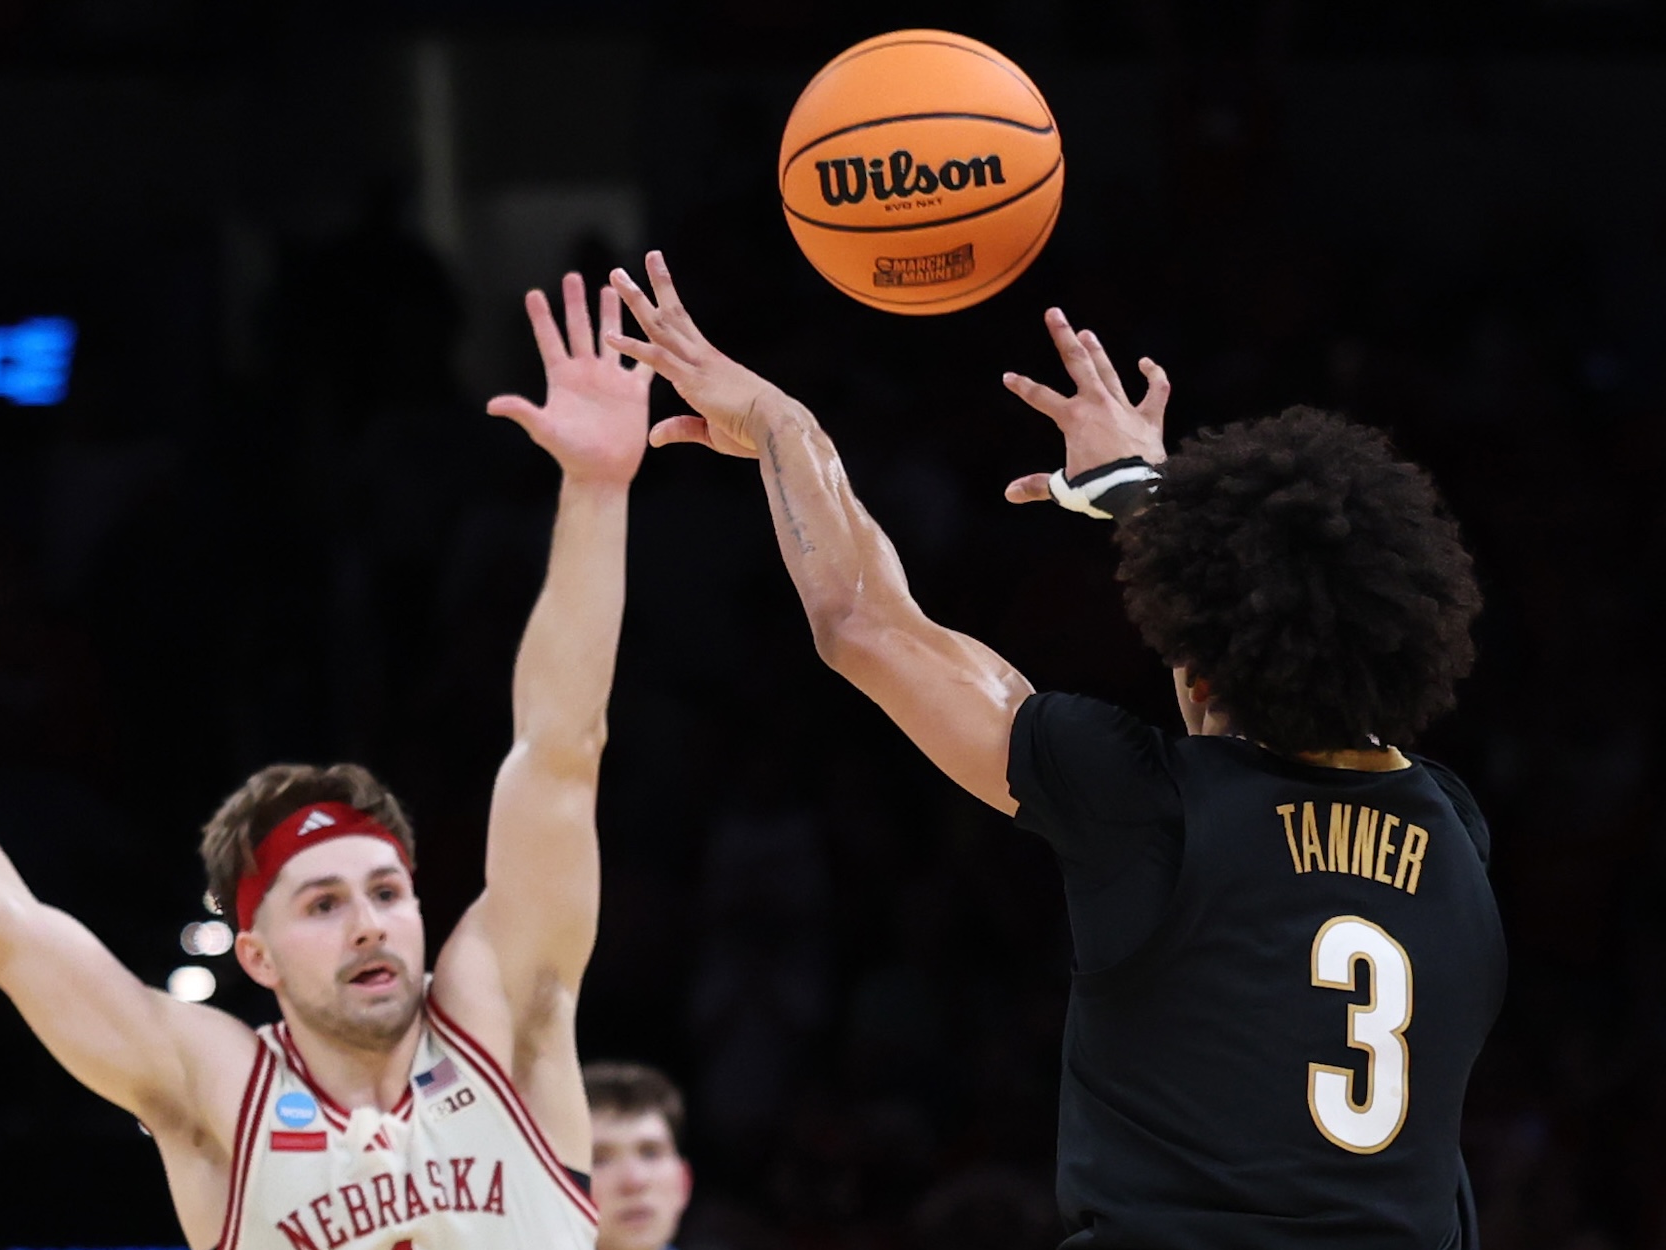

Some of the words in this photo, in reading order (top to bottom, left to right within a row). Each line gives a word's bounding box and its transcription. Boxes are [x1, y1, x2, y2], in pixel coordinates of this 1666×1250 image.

[815, 150, 1006, 207] Wilson
[1276, 801, 1430, 895] TANNER
[1307, 914, 1414, 1155] 3
